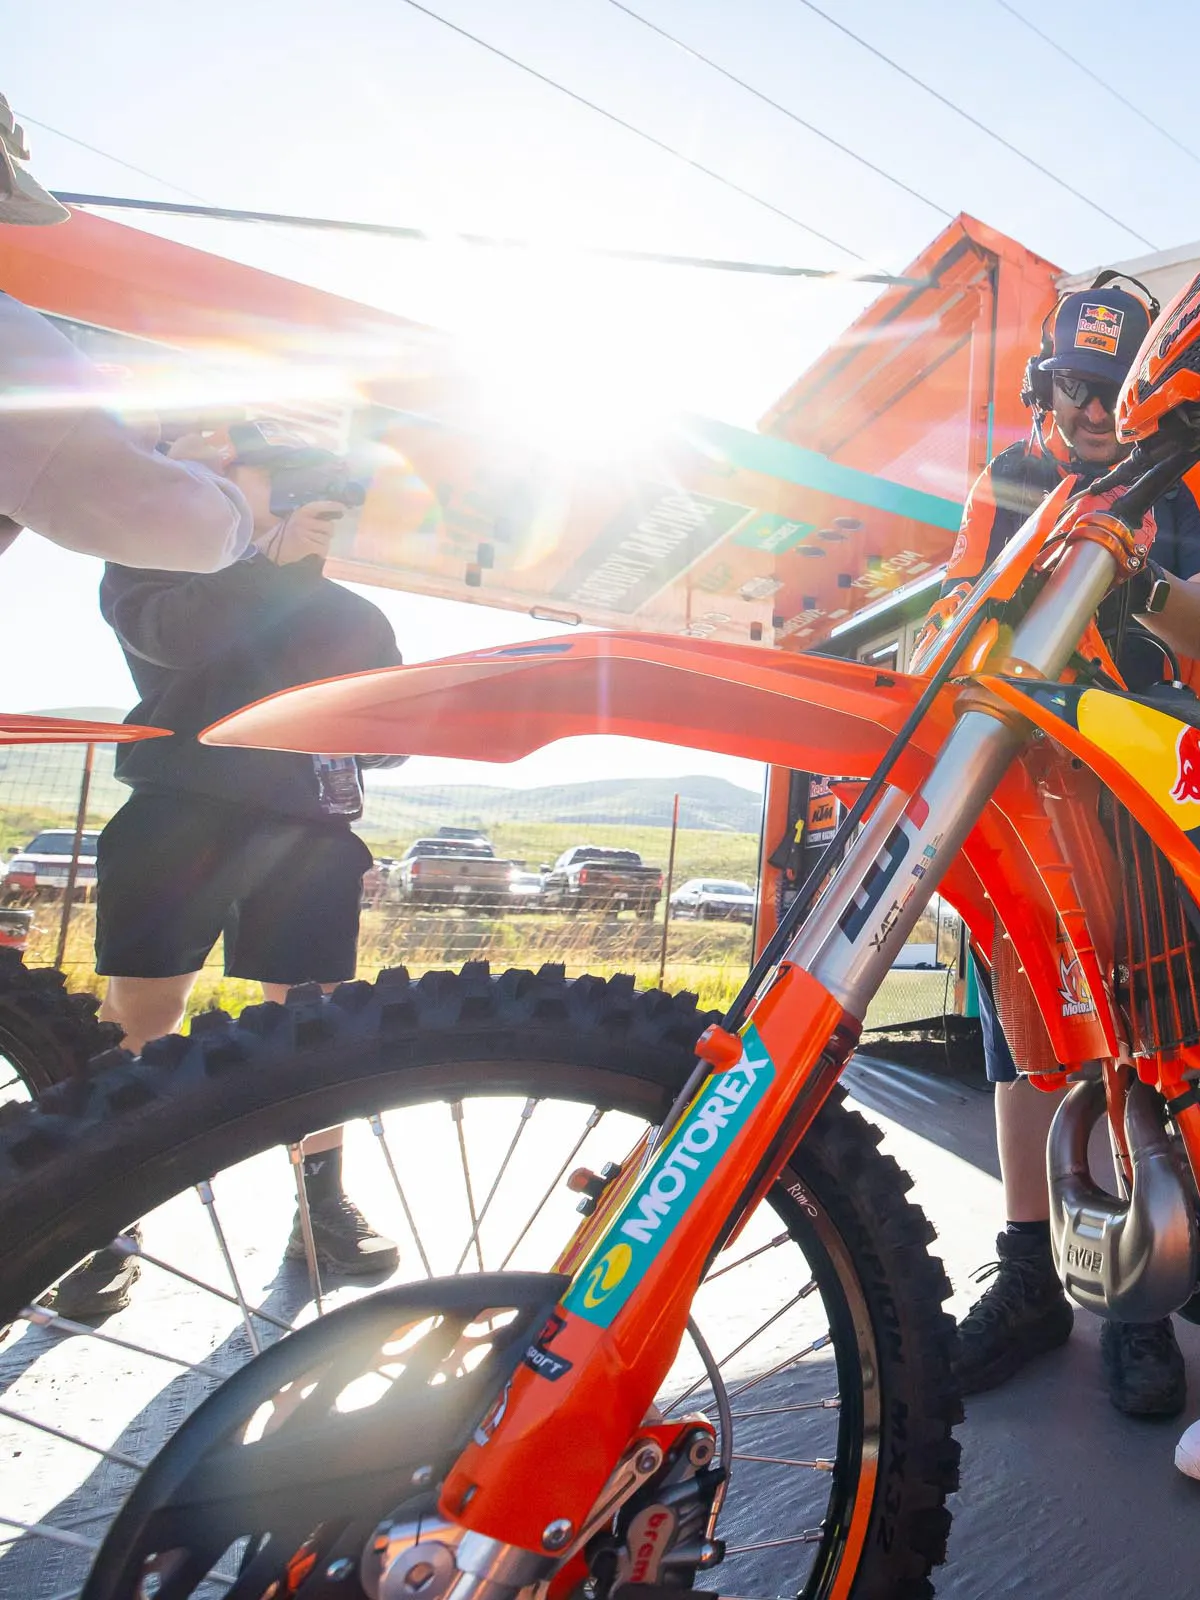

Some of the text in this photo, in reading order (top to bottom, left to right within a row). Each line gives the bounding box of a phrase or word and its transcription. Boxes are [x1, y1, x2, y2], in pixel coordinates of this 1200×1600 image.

[851, 549, 925, 590] KTM.COM
[811, 803, 834, 823] KTM
[620, 1048, 770, 1244] MOTOREX
[630, 1511, 670, 1583] brem
